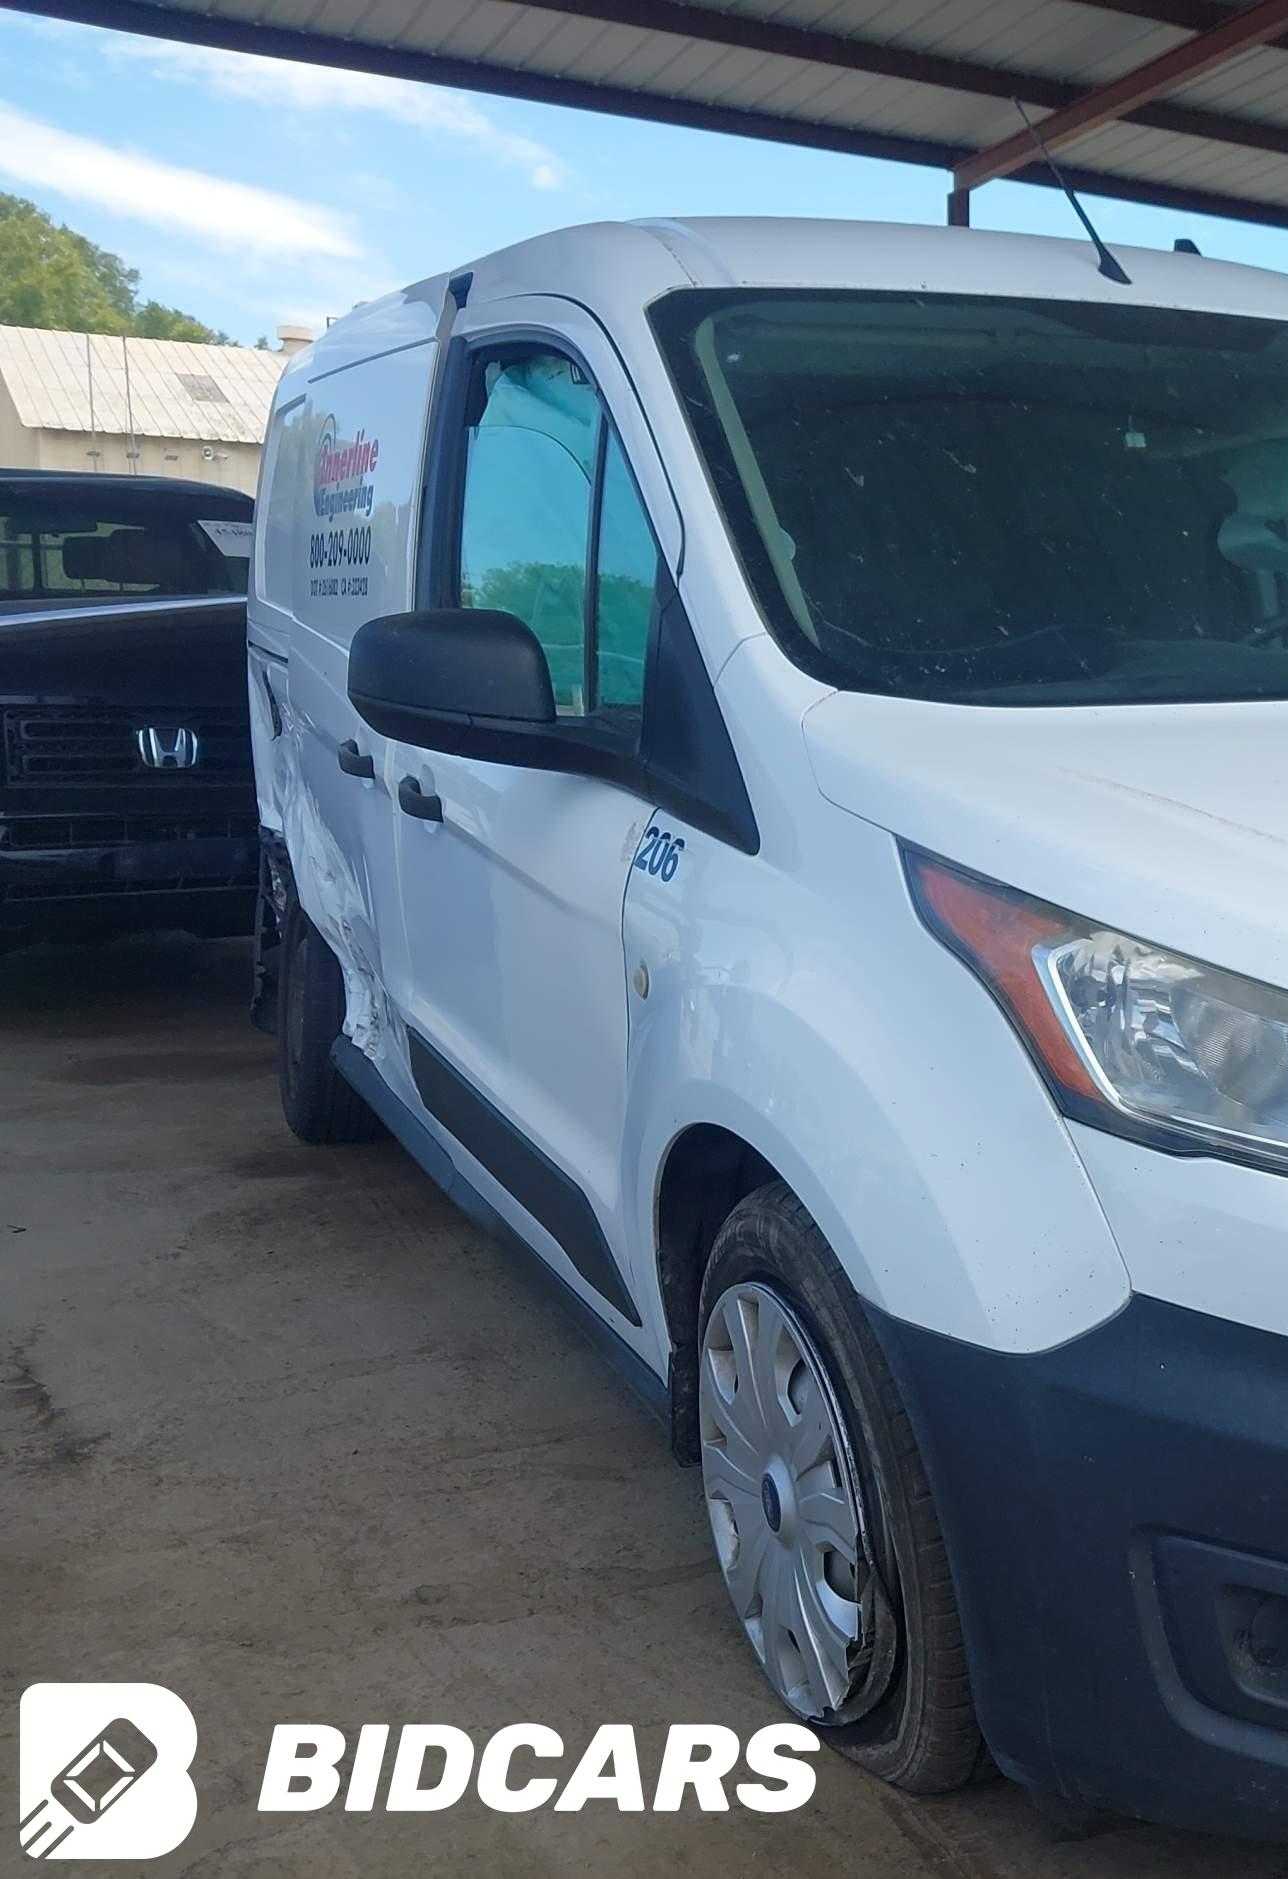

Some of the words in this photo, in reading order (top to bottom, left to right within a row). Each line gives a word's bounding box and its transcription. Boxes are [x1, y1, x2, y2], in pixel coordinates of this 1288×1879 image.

[319, 478, 374, 522] Engineering
[310, 526, 371, 569] 800-209-0000
[634, 826, 685, 882] 206
